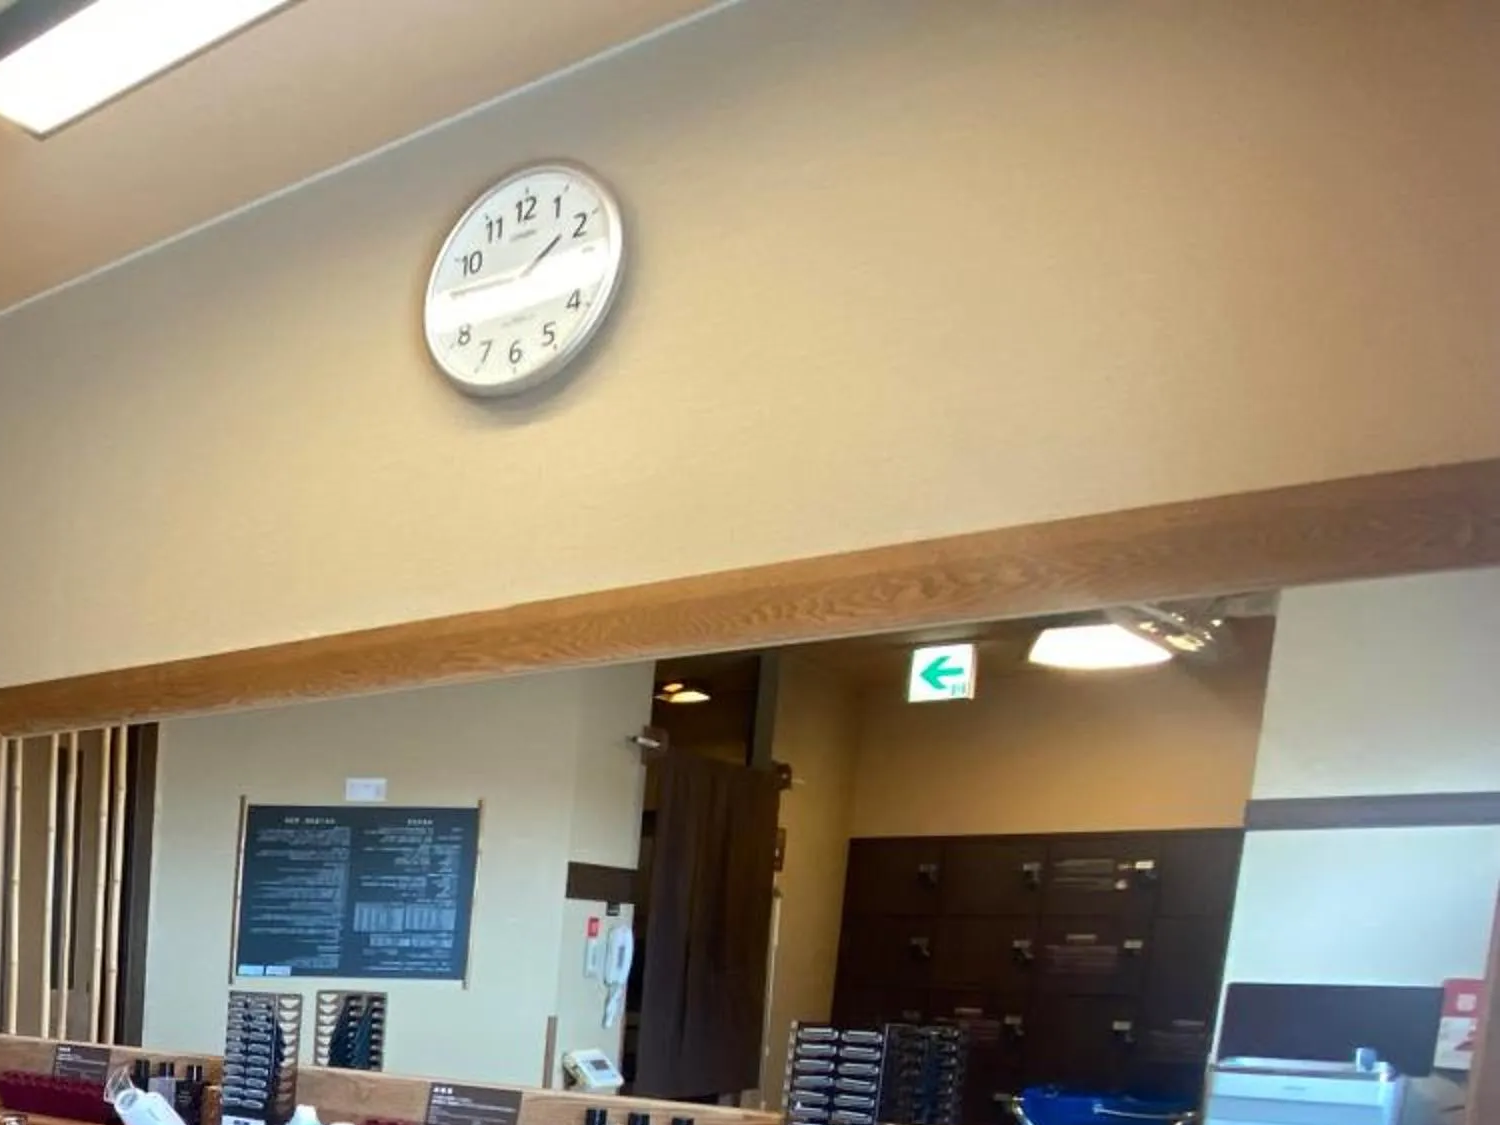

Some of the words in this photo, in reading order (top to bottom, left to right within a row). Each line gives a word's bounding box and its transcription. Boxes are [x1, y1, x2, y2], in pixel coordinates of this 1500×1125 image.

[515, 196, 538, 223] 12
[552, 196, 563, 218] 1
[485, 217, 504, 243] 11
[572, 213, 588, 238] 2
[461, 251, 483, 276] 10
[566, 288, 582, 311] 4
[458, 324, 472, 345] 8
[542, 321, 556, 347] 5
[480, 340, 494, 363] 7
[509, 339, 523, 364] 6
